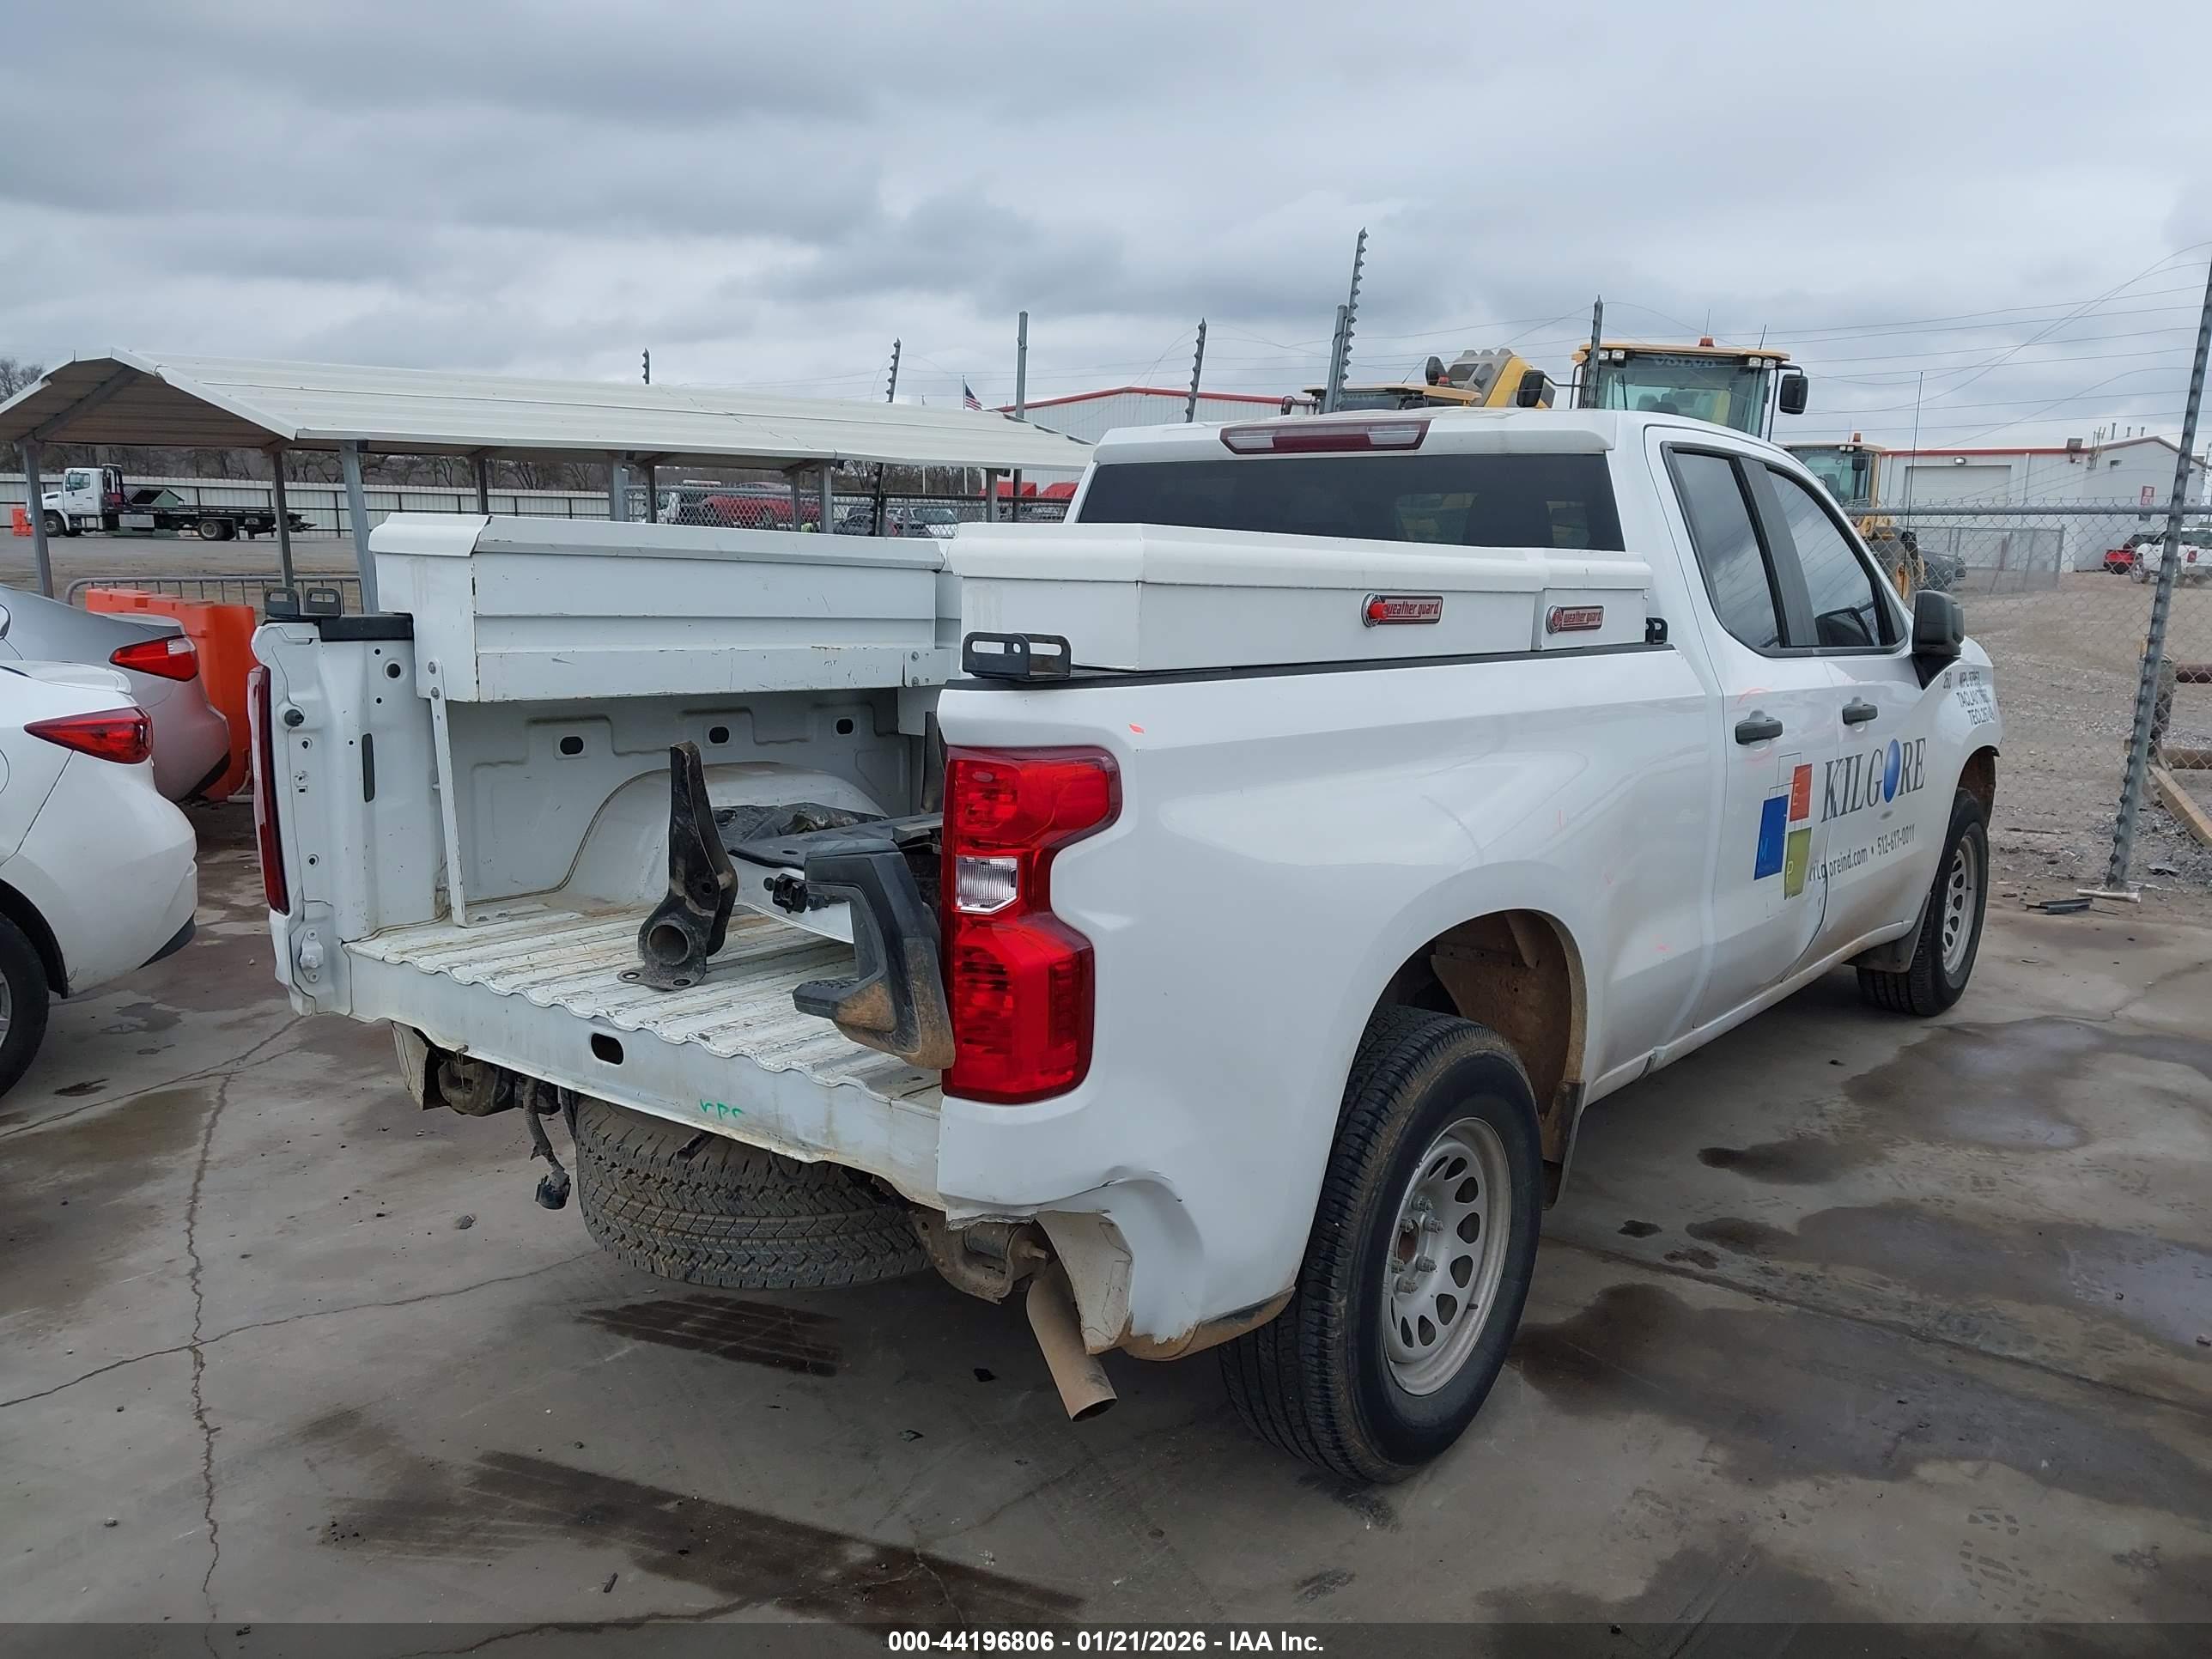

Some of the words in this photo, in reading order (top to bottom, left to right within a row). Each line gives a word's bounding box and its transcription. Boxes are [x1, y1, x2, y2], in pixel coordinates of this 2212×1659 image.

[1655, 356, 1717, 368] VOLVO
[1388, 601, 1417, 615] weather
[1419, 601, 1440, 616] guard
[1564, 611, 1586, 623] weather
[1587, 610, 1602, 623] guard
[1820, 738, 1926, 823] KILGORE
[1877, 823, 1916, 857] 512-617-0011
